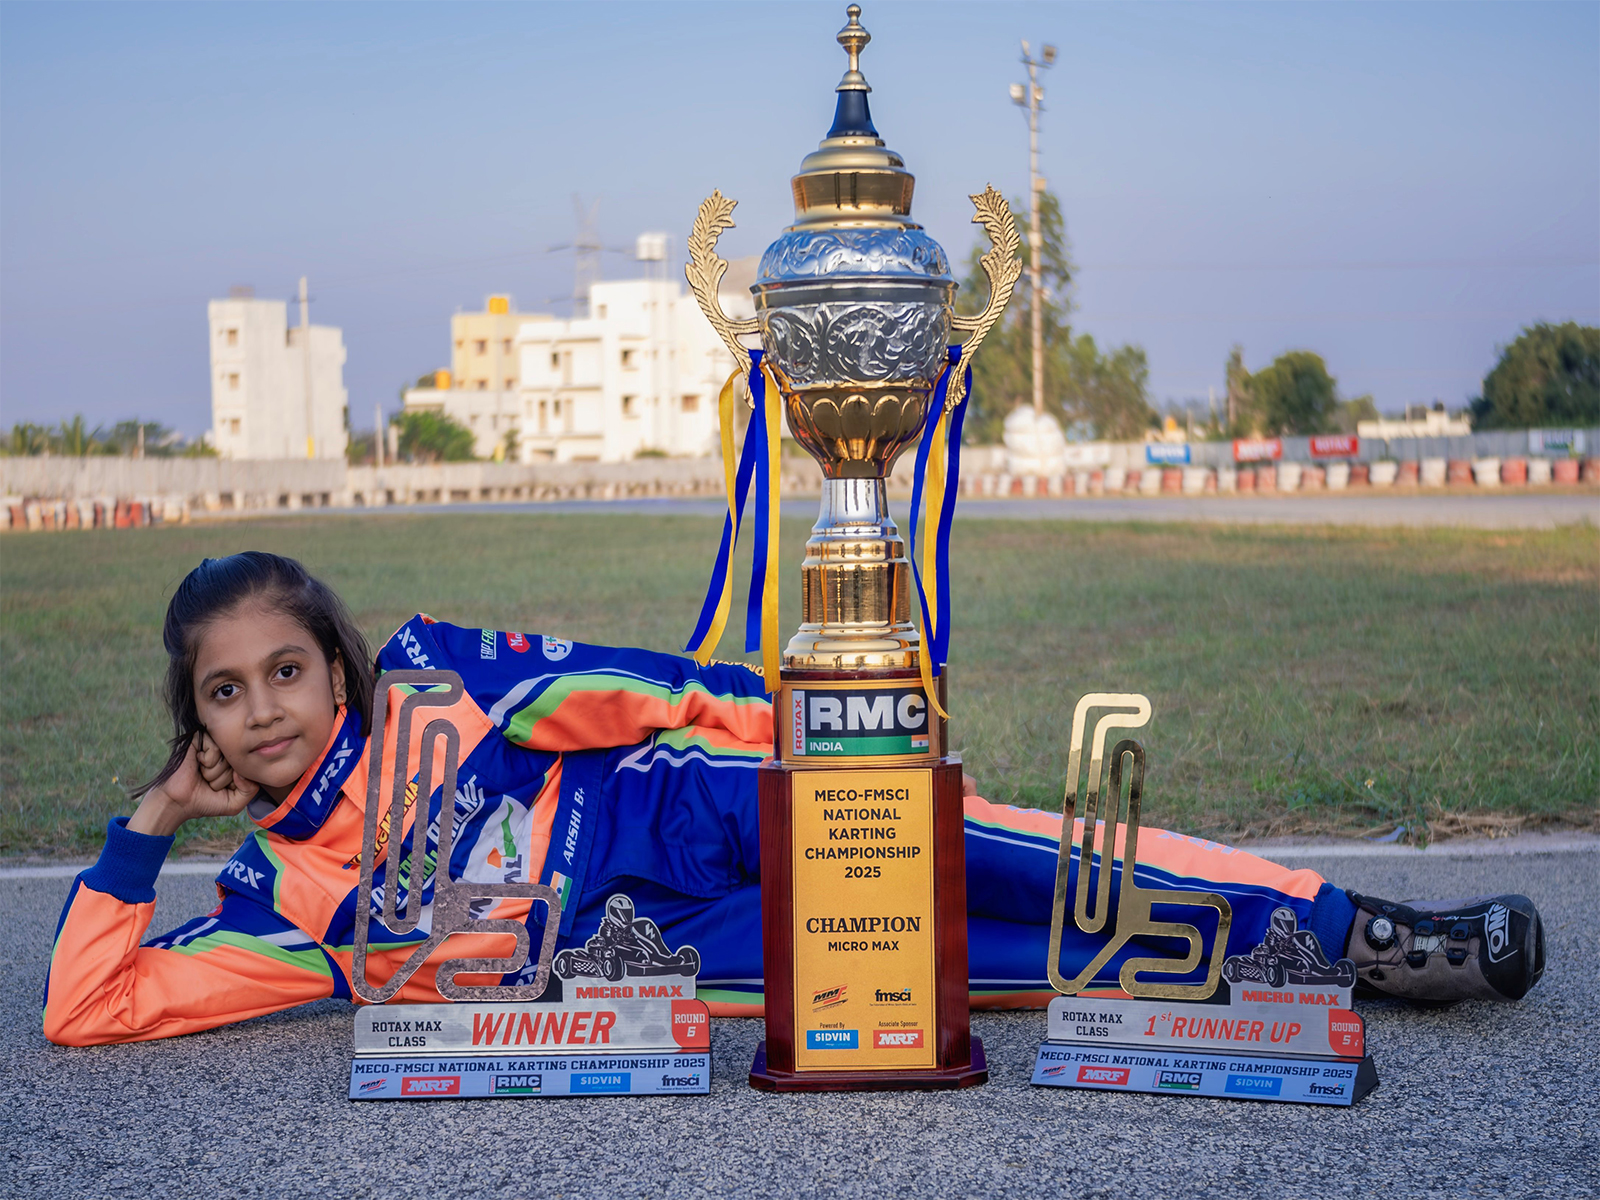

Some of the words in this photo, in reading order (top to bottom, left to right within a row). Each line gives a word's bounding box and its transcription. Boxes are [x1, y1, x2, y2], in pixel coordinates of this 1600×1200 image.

[810, 694, 926, 731] RMC
[795, 699, 803, 750] ROTAX
[810, 742, 844, 751] INDIA
[814, 789, 909, 801] MECO-FMSCI
[823, 808, 902, 821] NATIONAL
[563, 808, 582, 866] ARSHI
[574, 787, 585, 806] B+
[829, 828, 896, 840] KARTING
[805, 846, 921, 860] CHAMPIONSHIP
[844, 866, 882, 878] 2025
[806, 916, 922, 933] CHAMPION
[828, 941, 868, 952] MICRO
[872, 941, 900, 951] MAX
[576, 986, 635, 999] MICRO
[638, 985, 684, 998] MAX
[875, 988, 912, 1002] fmsci
[1242, 990, 1294, 1004] MICRO
[1299, 992, 1340, 1006] MAX
[674, 1013, 706, 1024] ROUND
[1062, 1011, 1096, 1022] ROTAX
[1099, 1013, 1123, 1024] MAX
[371, 1021, 413, 1033] ROTAX
[414, 1020, 442, 1032] MAX
[471, 1011, 617, 1046] WINNER
[900, 1020, 918, 1028] Sponsor
[1331, 1022, 1360, 1033] ROUND
[686, 1026, 697, 1037] 6
[1076, 1026, 1109, 1037] CLASS
[1171, 1017, 1264, 1043] RUNNER
[1270, 1022, 1301, 1044] UP
[388, 1036, 427, 1048] CLASS
[815, 1032, 851, 1042] SIDVIN
[878, 1033, 918, 1045] MRF
[1342, 1034, 1352, 1045] 5
[354, 1063, 435, 1074] MECO-FMSCI
[438, 1061, 503, 1072] NATIONAL
[507, 1060, 567, 1071] KARTING
[571, 1058, 670, 1070] CHAMPIONSHIP
[674, 1058, 705, 1068] 2025
[1040, 1051, 1109, 1064] MECO-FMSCI
[1112, 1055, 1169, 1067] NATIONAL
[1173, 1059, 1226, 1071] KARTING
[1229, 1063, 1320, 1077] CHAMPIONSHIP
[1322, 1068, 1353, 1078] 2025
[580, 1076, 621, 1085] SIDVIN
[661, 1073, 700, 1086] fmsci
[1082, 1069, 1124, 1081] MRF
[1161, 1072, 1200, 1083] RMC
[407, 1080, 454, 1092] MRF
[497, 1076, 540, 1087] RMC
[1235, 1078, 1273, 1089] SIDVIN
[1309, 1082, 1346, 1095] fmsci
